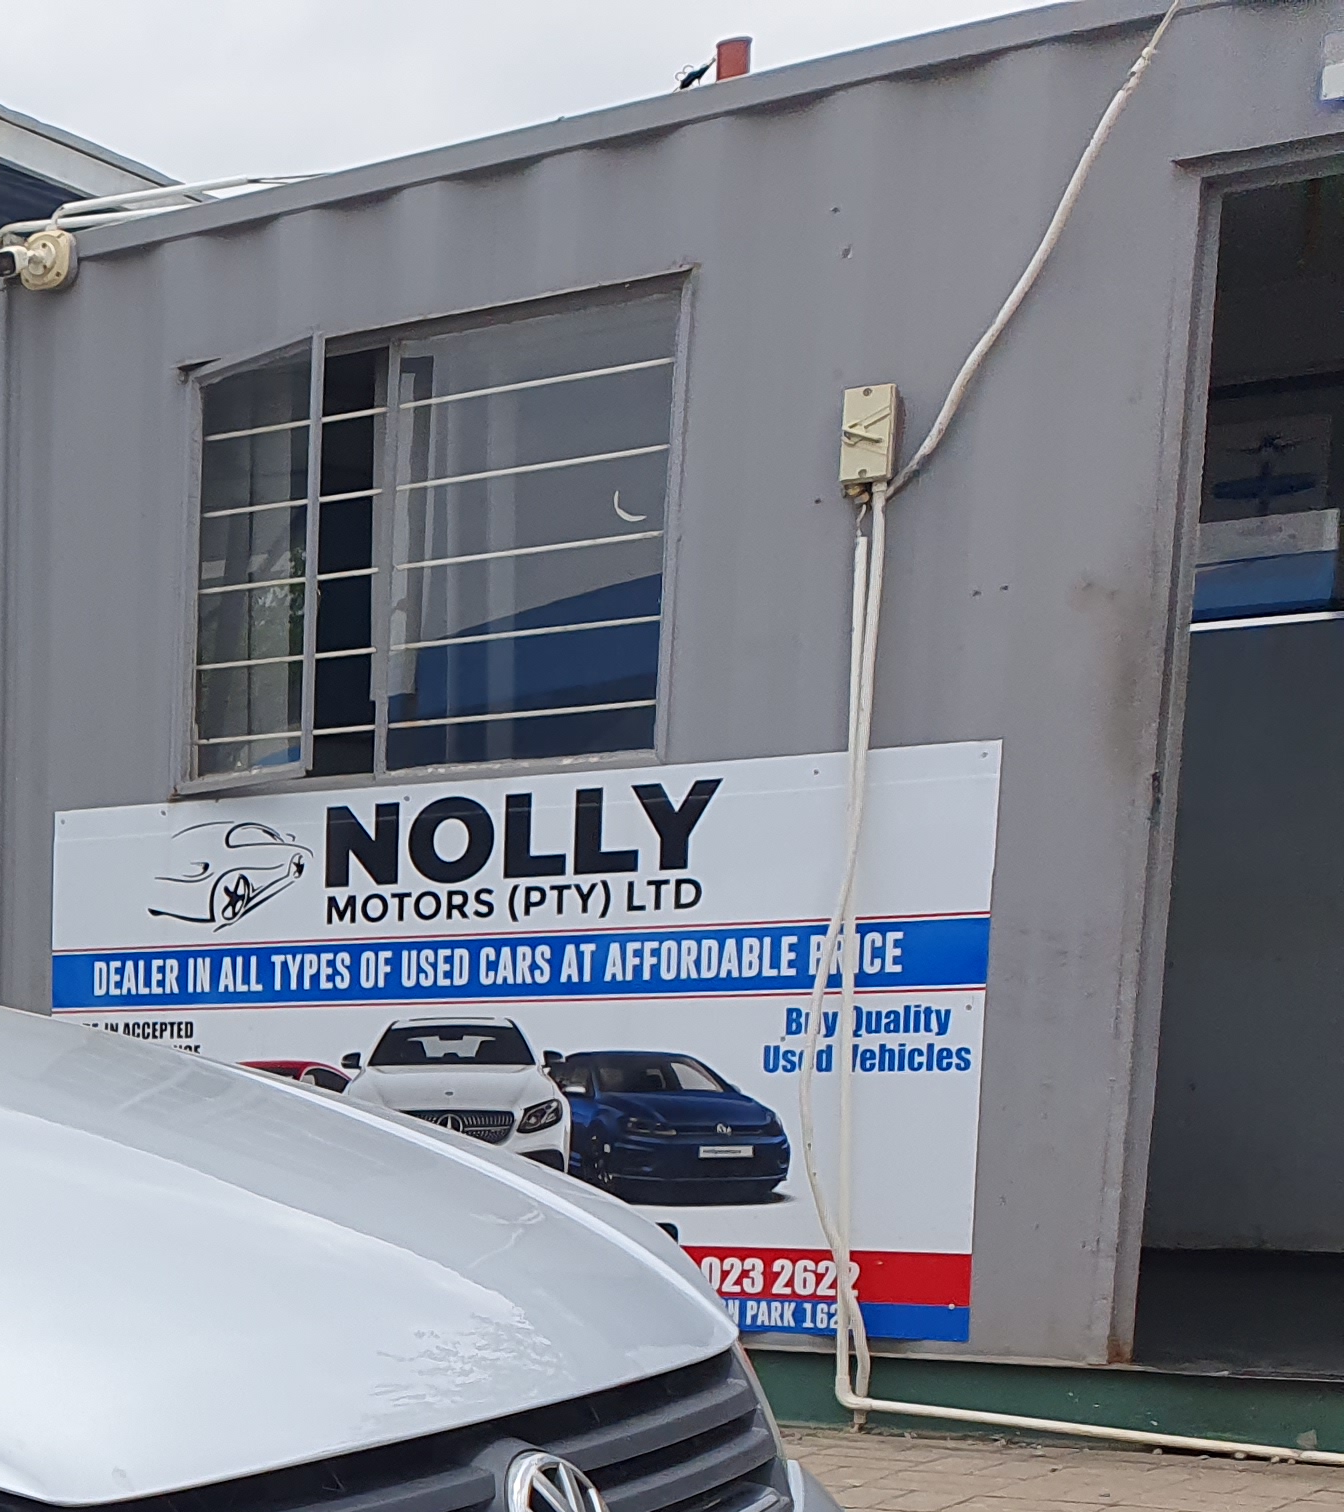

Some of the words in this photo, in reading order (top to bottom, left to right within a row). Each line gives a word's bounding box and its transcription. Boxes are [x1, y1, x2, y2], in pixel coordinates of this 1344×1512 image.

[325, 778, 723, 888] NOLLY
[326, 887, 495, 925] MOTORS
[508, 880, 611, 922] (PTY)
[626, 878, 703, 912] LTD
[93, 957, 179, 996] DEALER
[188, 957, 210, 993] IN
[218, 955, 262, 993] ALL
[270, 951, 351, 991] TYPES
[360, 950, 392, 988] OF
[401, 948, 469, 988] USED
[479, 944, 551, 985] CARS
[560, 943, 596, 983] AT
[604, 935, 799, 982] AFFORDABLE
[808, 931, 904, 975] PRICE
[123, 1021, 194, 1039] ACCEPTED
[746, 1300, 796, 1327] PARK
[803, 1302, 839, 1329] 162
